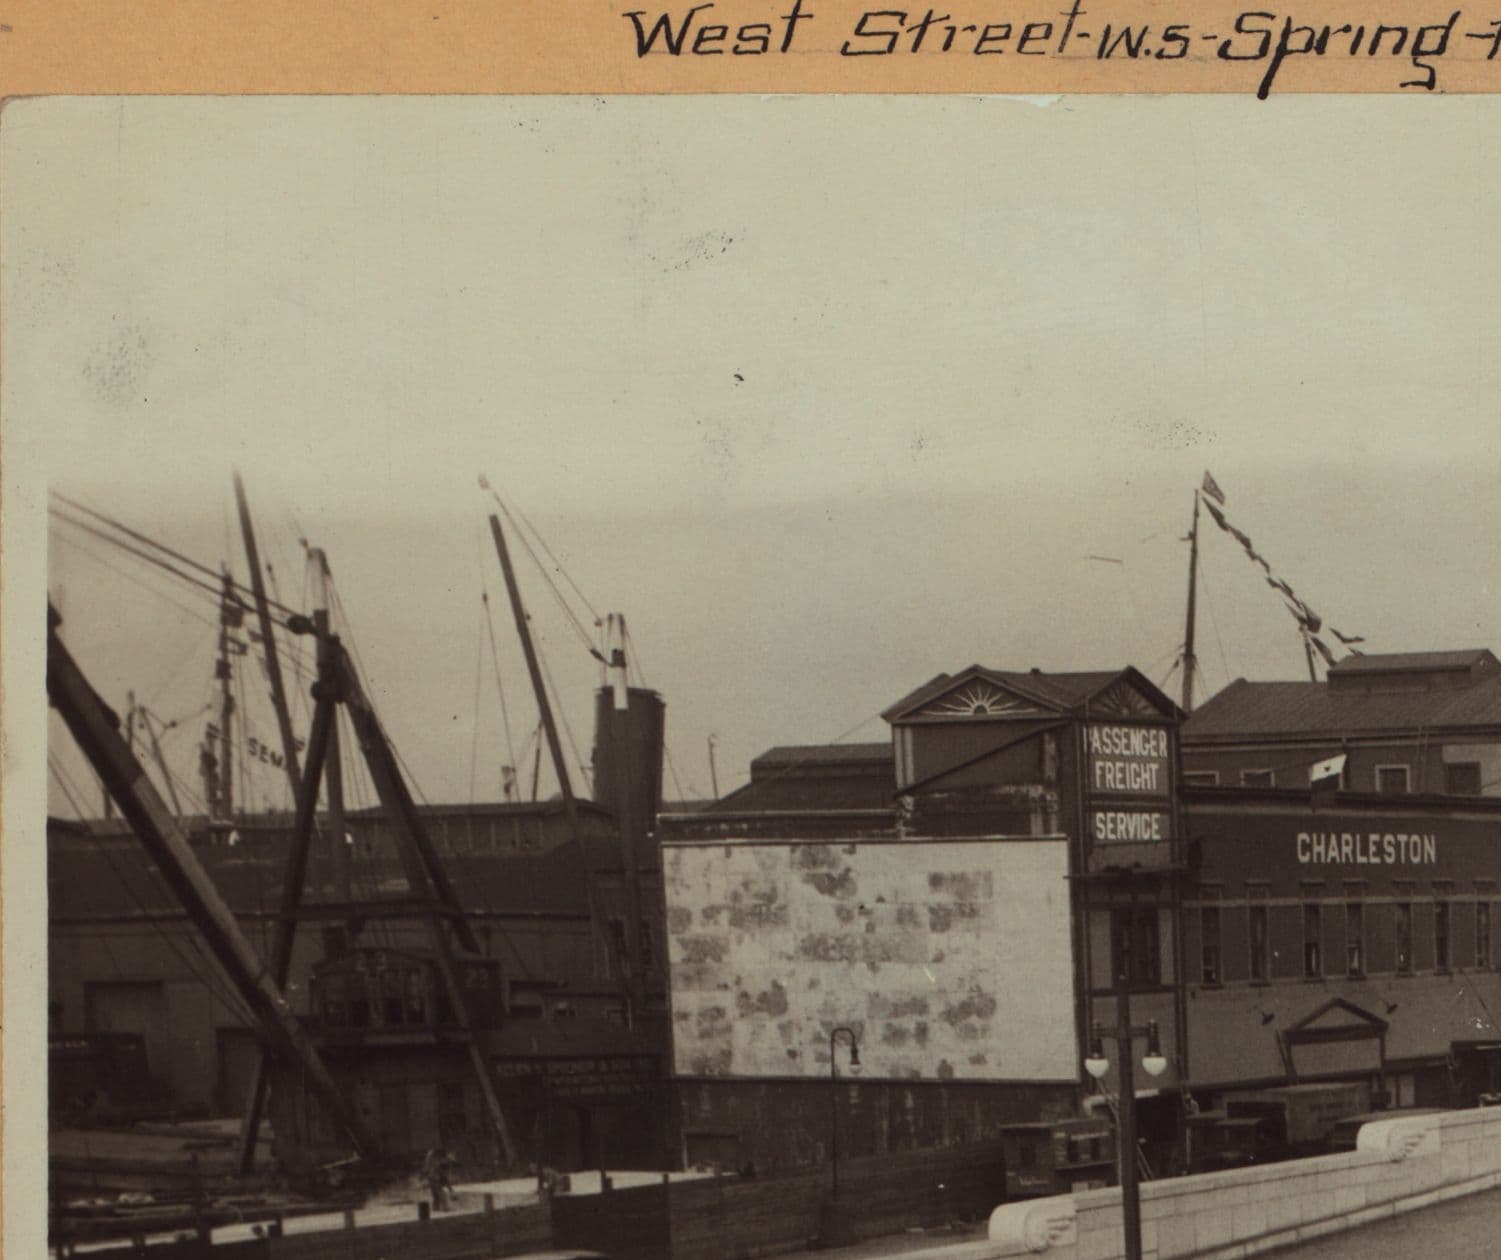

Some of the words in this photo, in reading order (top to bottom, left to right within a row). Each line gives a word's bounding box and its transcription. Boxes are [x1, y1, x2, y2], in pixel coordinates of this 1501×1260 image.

[622, 0, 814, 59] West
[1095, 761, 1159, 790] FREIGHT
[1095, 811, 1161, 840] SERVICE
[1297, 831, 1436, 865] CHARLESTON
